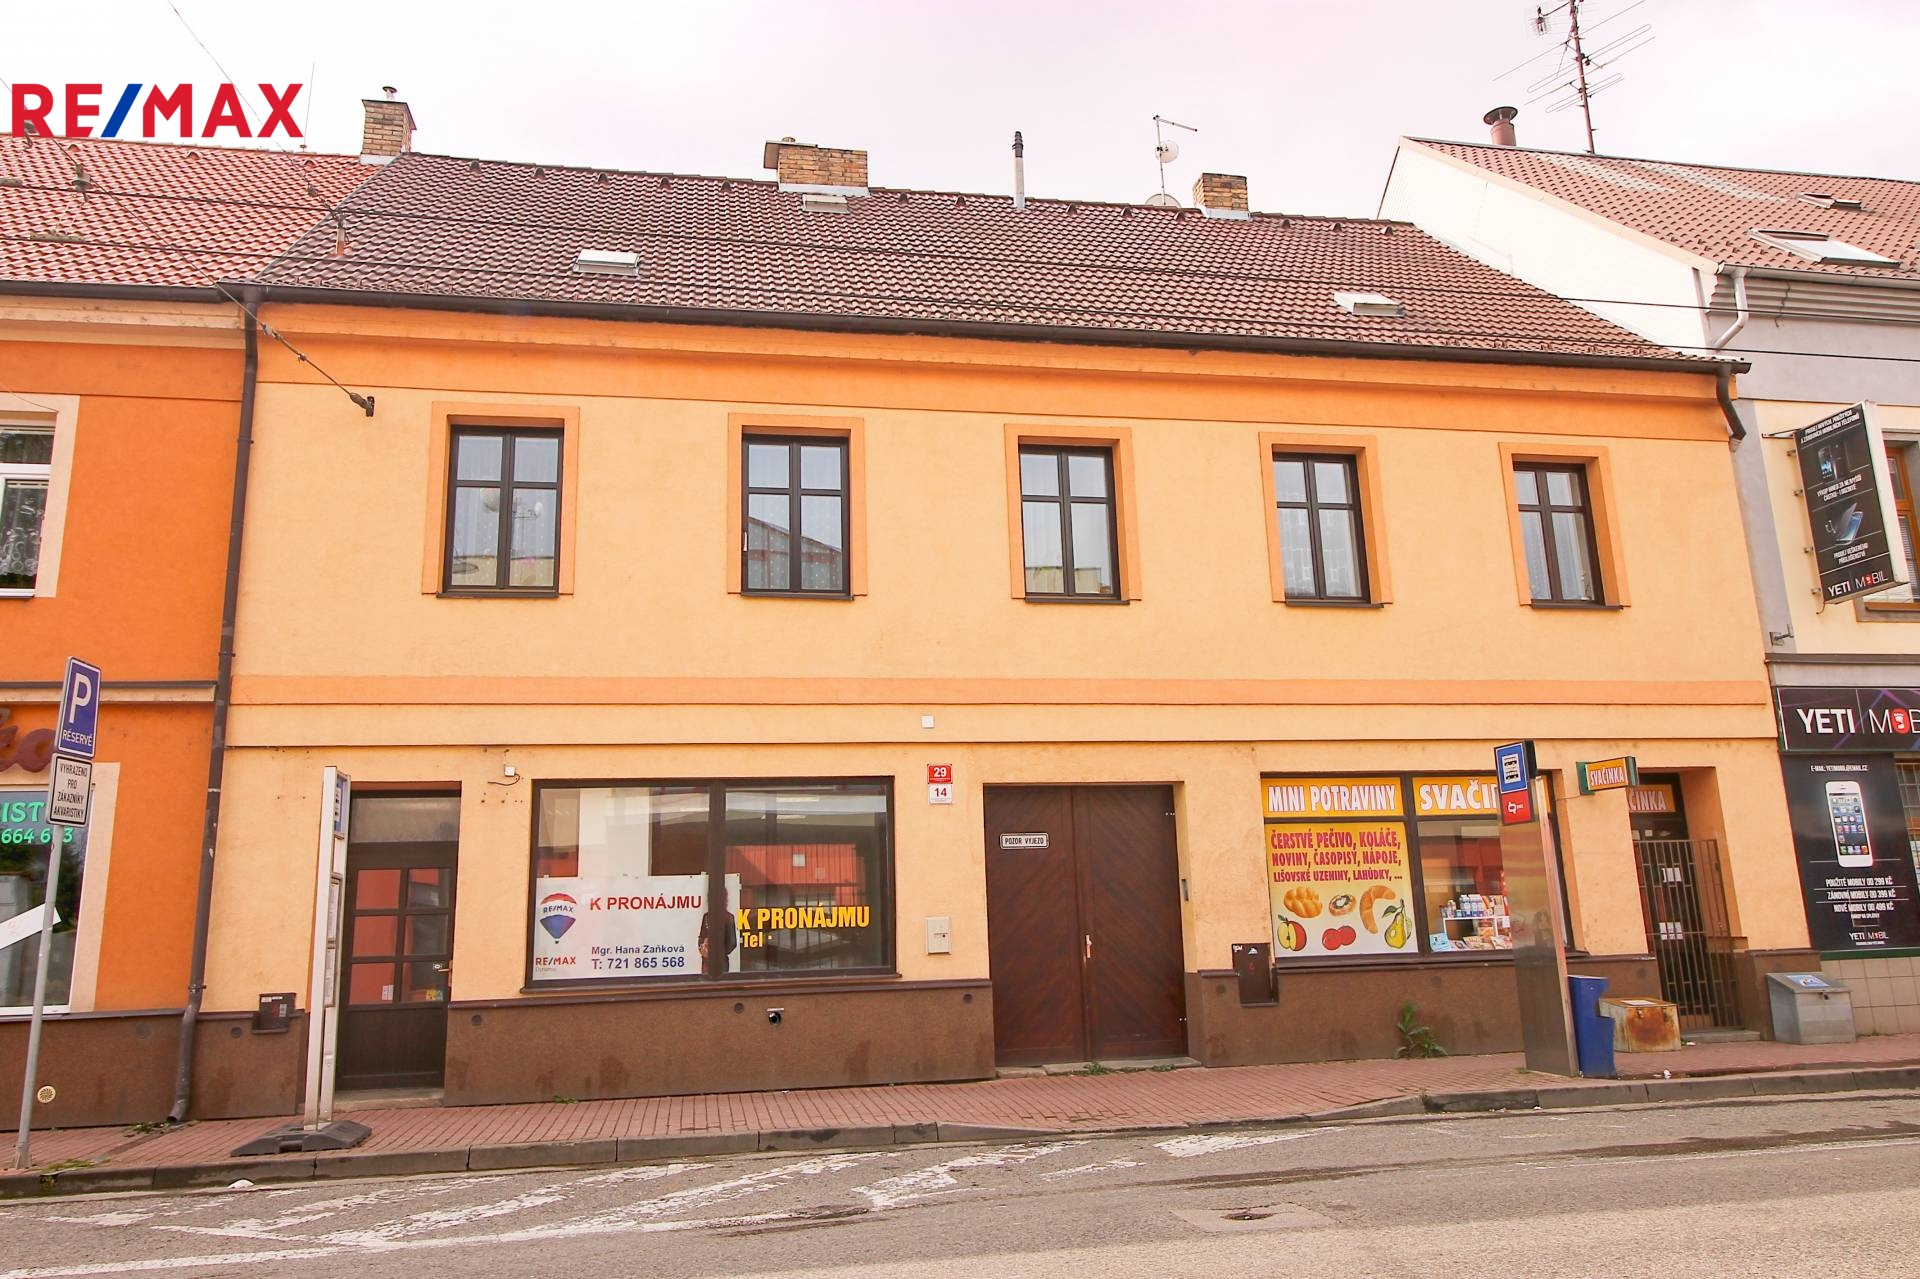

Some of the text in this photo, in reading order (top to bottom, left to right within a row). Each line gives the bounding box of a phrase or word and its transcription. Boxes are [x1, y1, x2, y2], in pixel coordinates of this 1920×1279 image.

[1828, 580, 1852, 597] YETI
[68, 672, 92, 724] P
[1796, 708, 1856, 734] YETI
[62, 729, 93, 747] RÉSERVÉ
[59, 762, 88, 777] VYHRAZENO
[933, 767, 947, 778] 29
[1590, 766, 1625, 787] SVAČINKA
[67, 778, 78, 790] PRO
[934, 787, 948, 797] 14
[1268, 784, 1396, 812] MINI POTRAVINY
[40, 827, 74, 844] 63
[1004, 837, 1023, 845] POZOR
[1270, 827, 1401, 851] ČERSTVÉ PEČIVO, KOLÁČE,
[1272, 847, 1402, 869] NOVINY, ČASOPISY, NÁPOJE,
[1273, 868, 1311, 883] LIŠOVSKÉ
[1313, 869, 1351, 883] UZENINY,
[543, 905, 575, 914] RE/MAX
[589, 893, 702, 911] K PRONÁJMU
[736, 901, 871, 931] K PRONÁJMU
[1849, 933, 1865, 941] YETI
[591, 944, 685, 956] Mgr. Hana Zaňková
[535, 956, 577, 966] RE/MAX
[591, 956, 686, 970] T: 721 865 568
